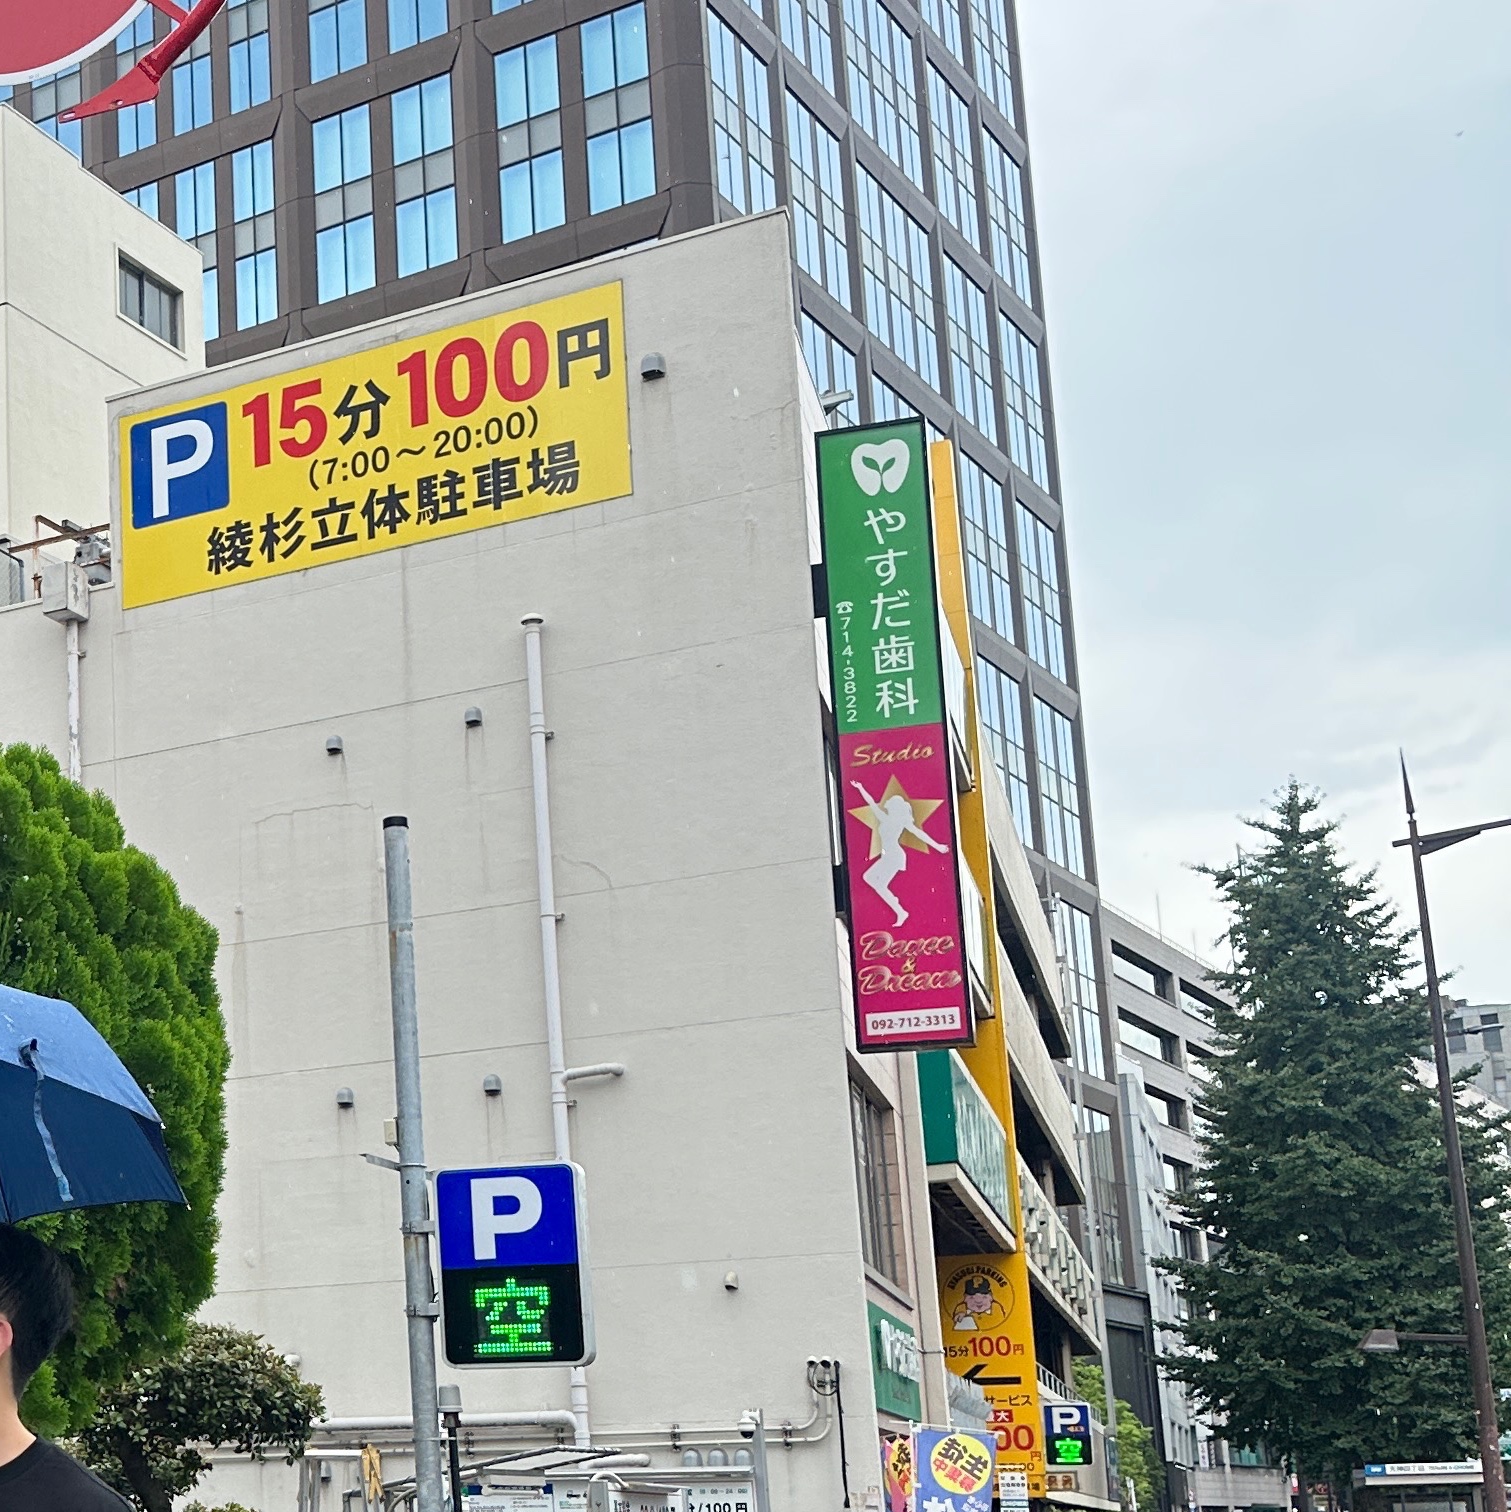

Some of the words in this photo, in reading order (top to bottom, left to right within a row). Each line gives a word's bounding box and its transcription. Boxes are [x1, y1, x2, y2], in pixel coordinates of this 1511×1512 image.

[149, 417, 215, 520] P
[206, 440, 581, 576] 綾杉立体駐車場
[863, 507, 920, 719] やすだ歯科
[848, 741, 935, 768] Studio
[859, 929, 955, 961] Dance
[857, 964, 962, 996] Dream
[870, 1012, 956, 1031] 092-712-3313
[470, 1175, 544, 1261] P
[473, 1277, 554, 1355] 空
[1051, 1407, 1082, 1434] P
[1054, 1437, 1084, 1463] 空
